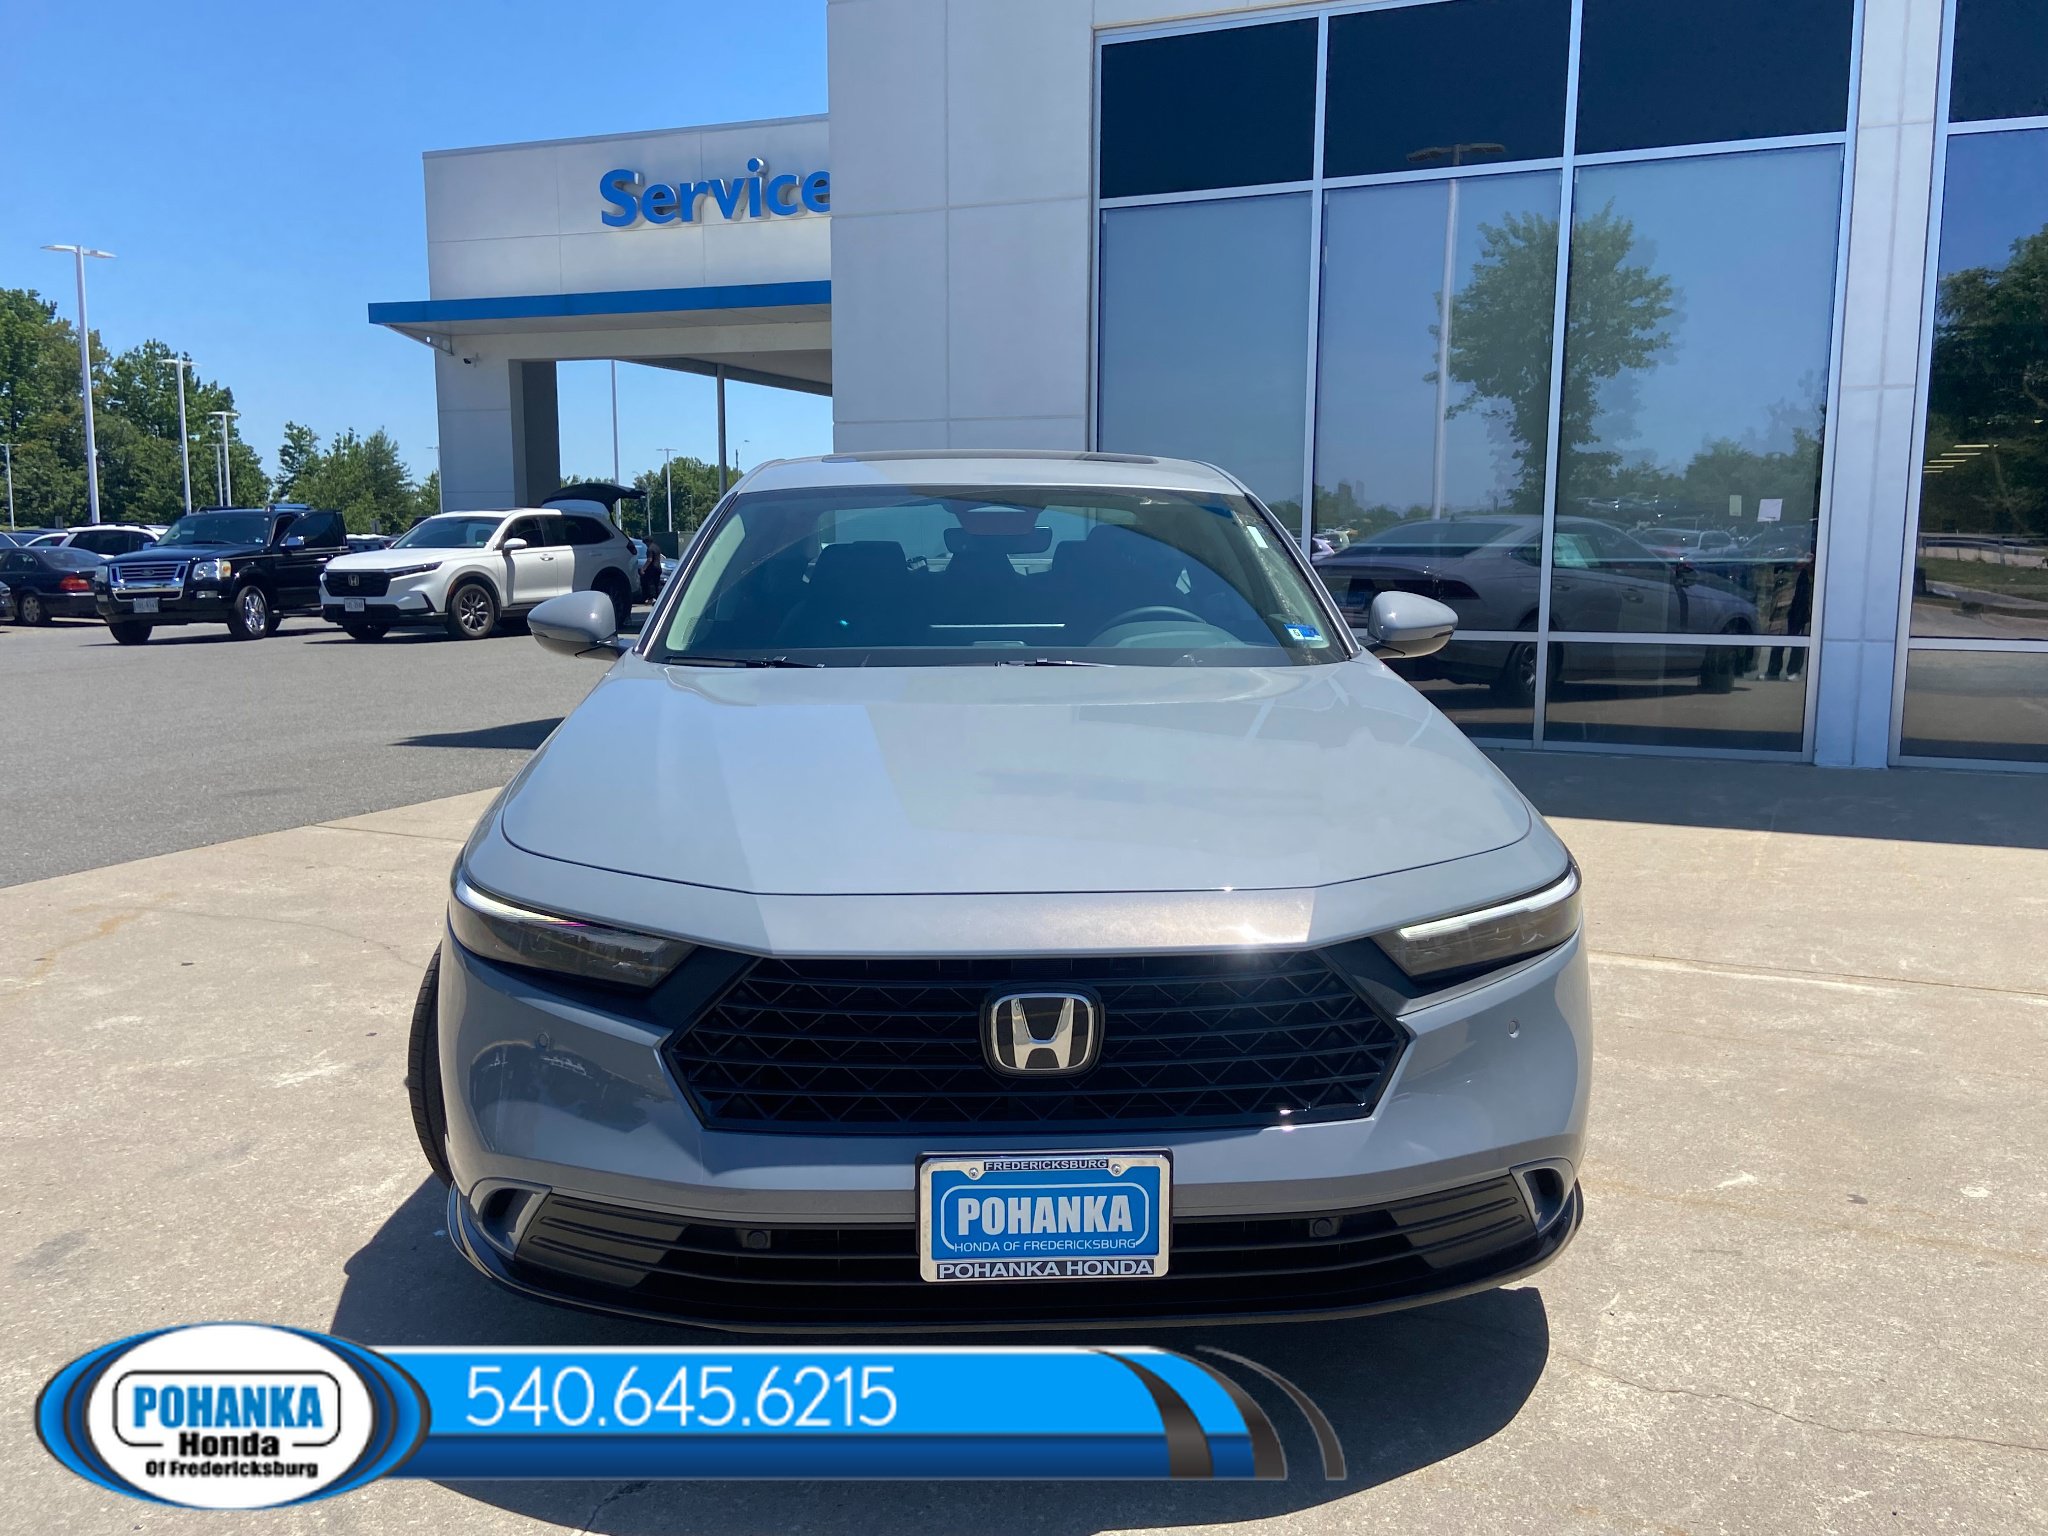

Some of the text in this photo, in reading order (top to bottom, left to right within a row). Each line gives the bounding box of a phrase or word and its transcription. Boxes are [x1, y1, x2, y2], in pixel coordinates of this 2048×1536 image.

[600, 157, 831, 228] Service
[985, 1158, 1108, 1171] FREDERICKSBURG
[957, 1194, 1133, 1236] POHANKA
[954, 1238, 1137, 1252] HONDA OF FREDERICKSBURG
[939, 1260, 1153, 1279] POHANKA HONDA
